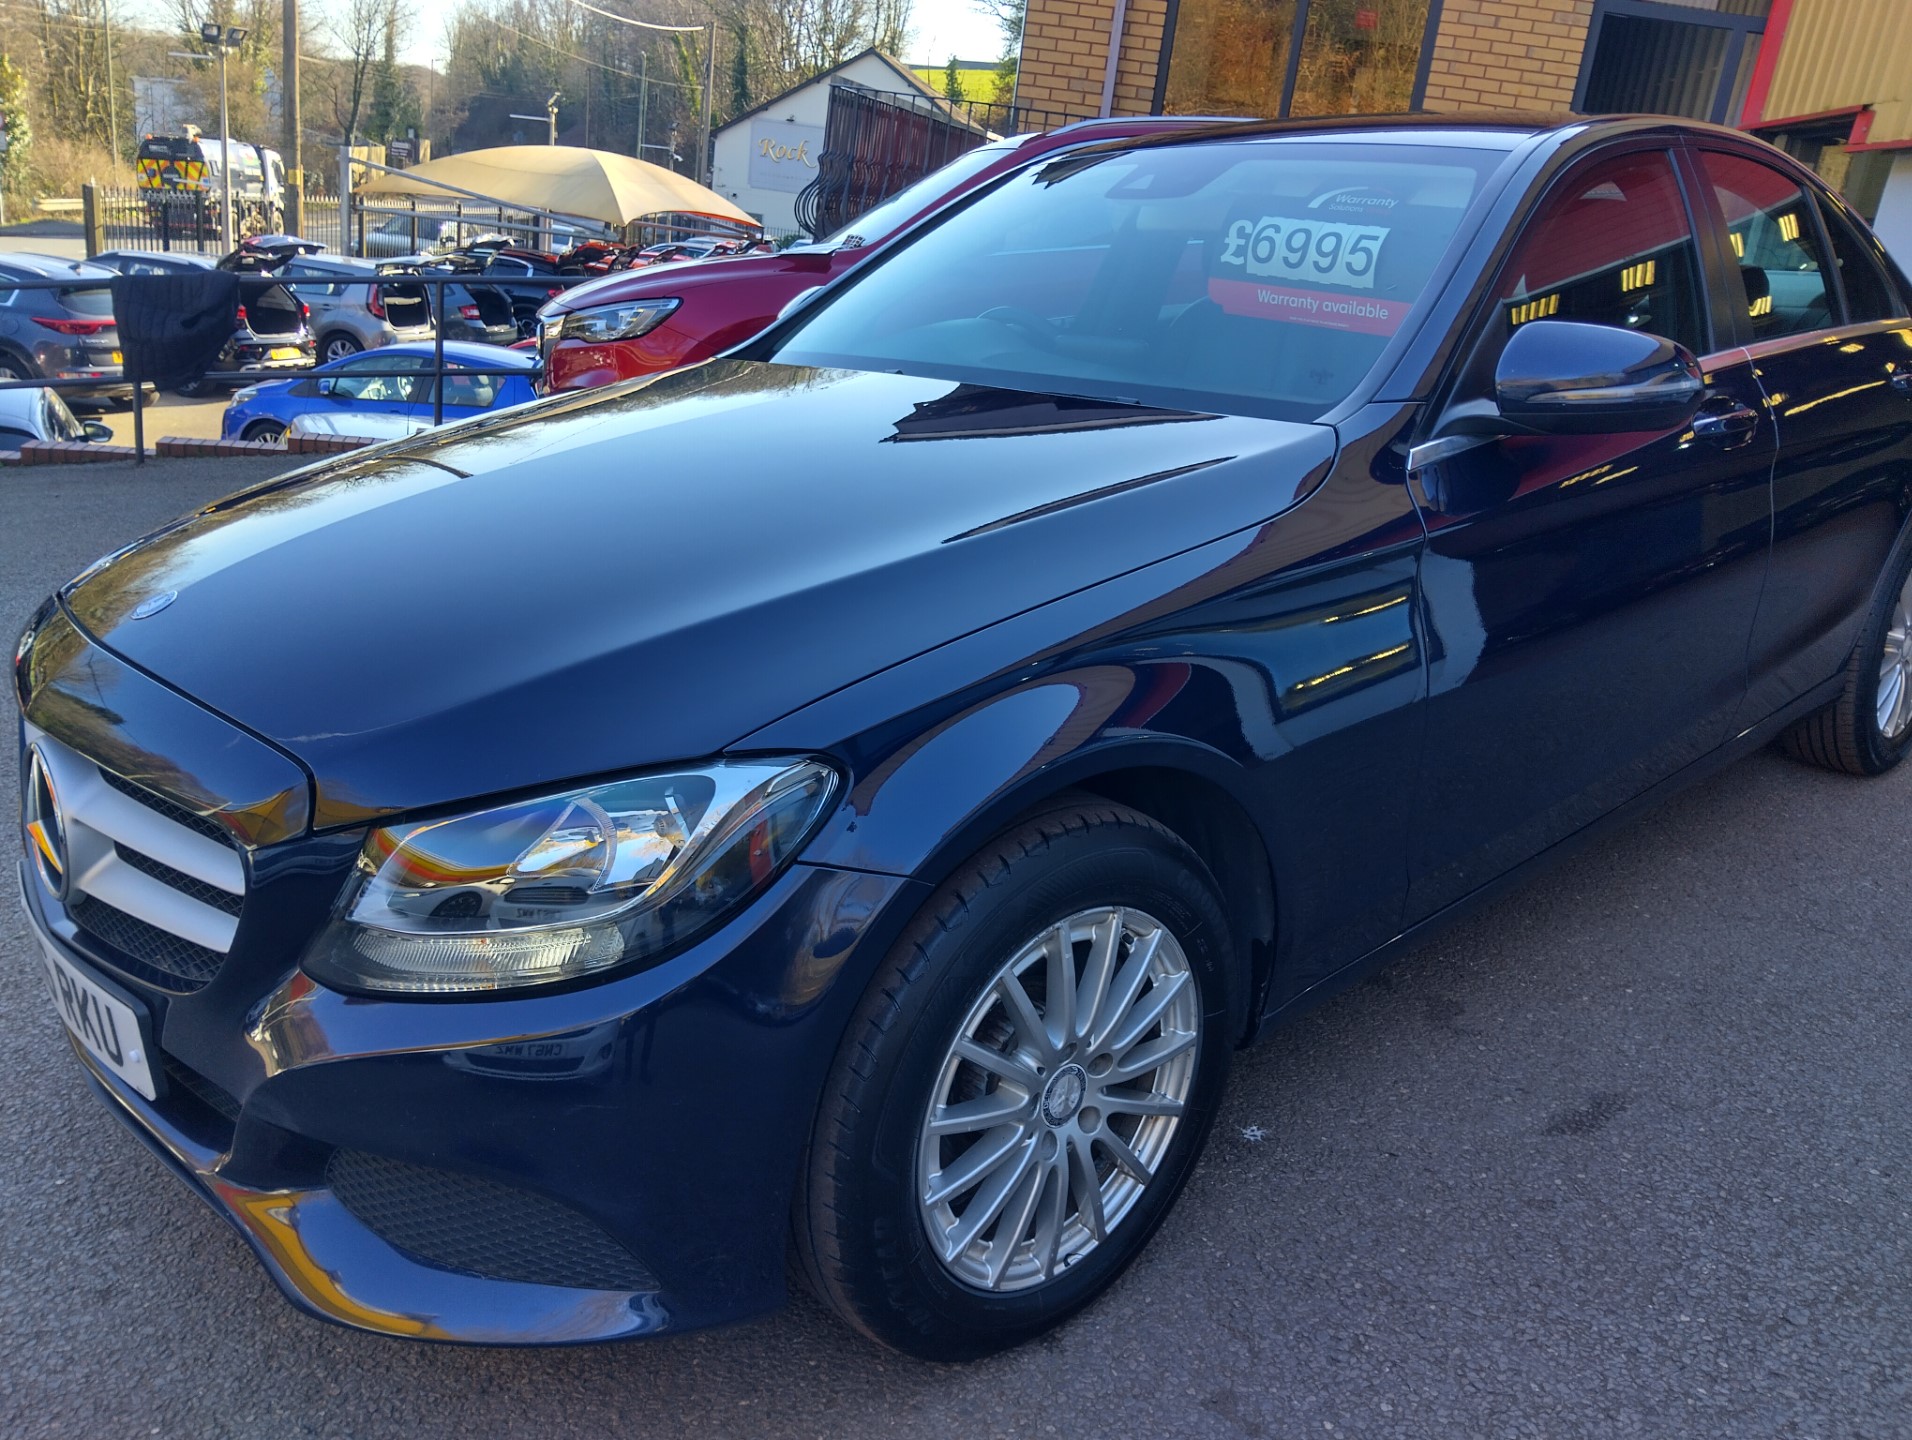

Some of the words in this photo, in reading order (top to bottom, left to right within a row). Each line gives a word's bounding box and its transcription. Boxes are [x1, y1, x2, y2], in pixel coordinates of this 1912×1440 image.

[758, 138, 817, 168] Rock
[1336, 194, 1399, 209] Warranty
[1221, 219, 1380, 277] £6995
[1258, 289, 1319, 313] Warranty
[1323, 301, 1389, 320] available
